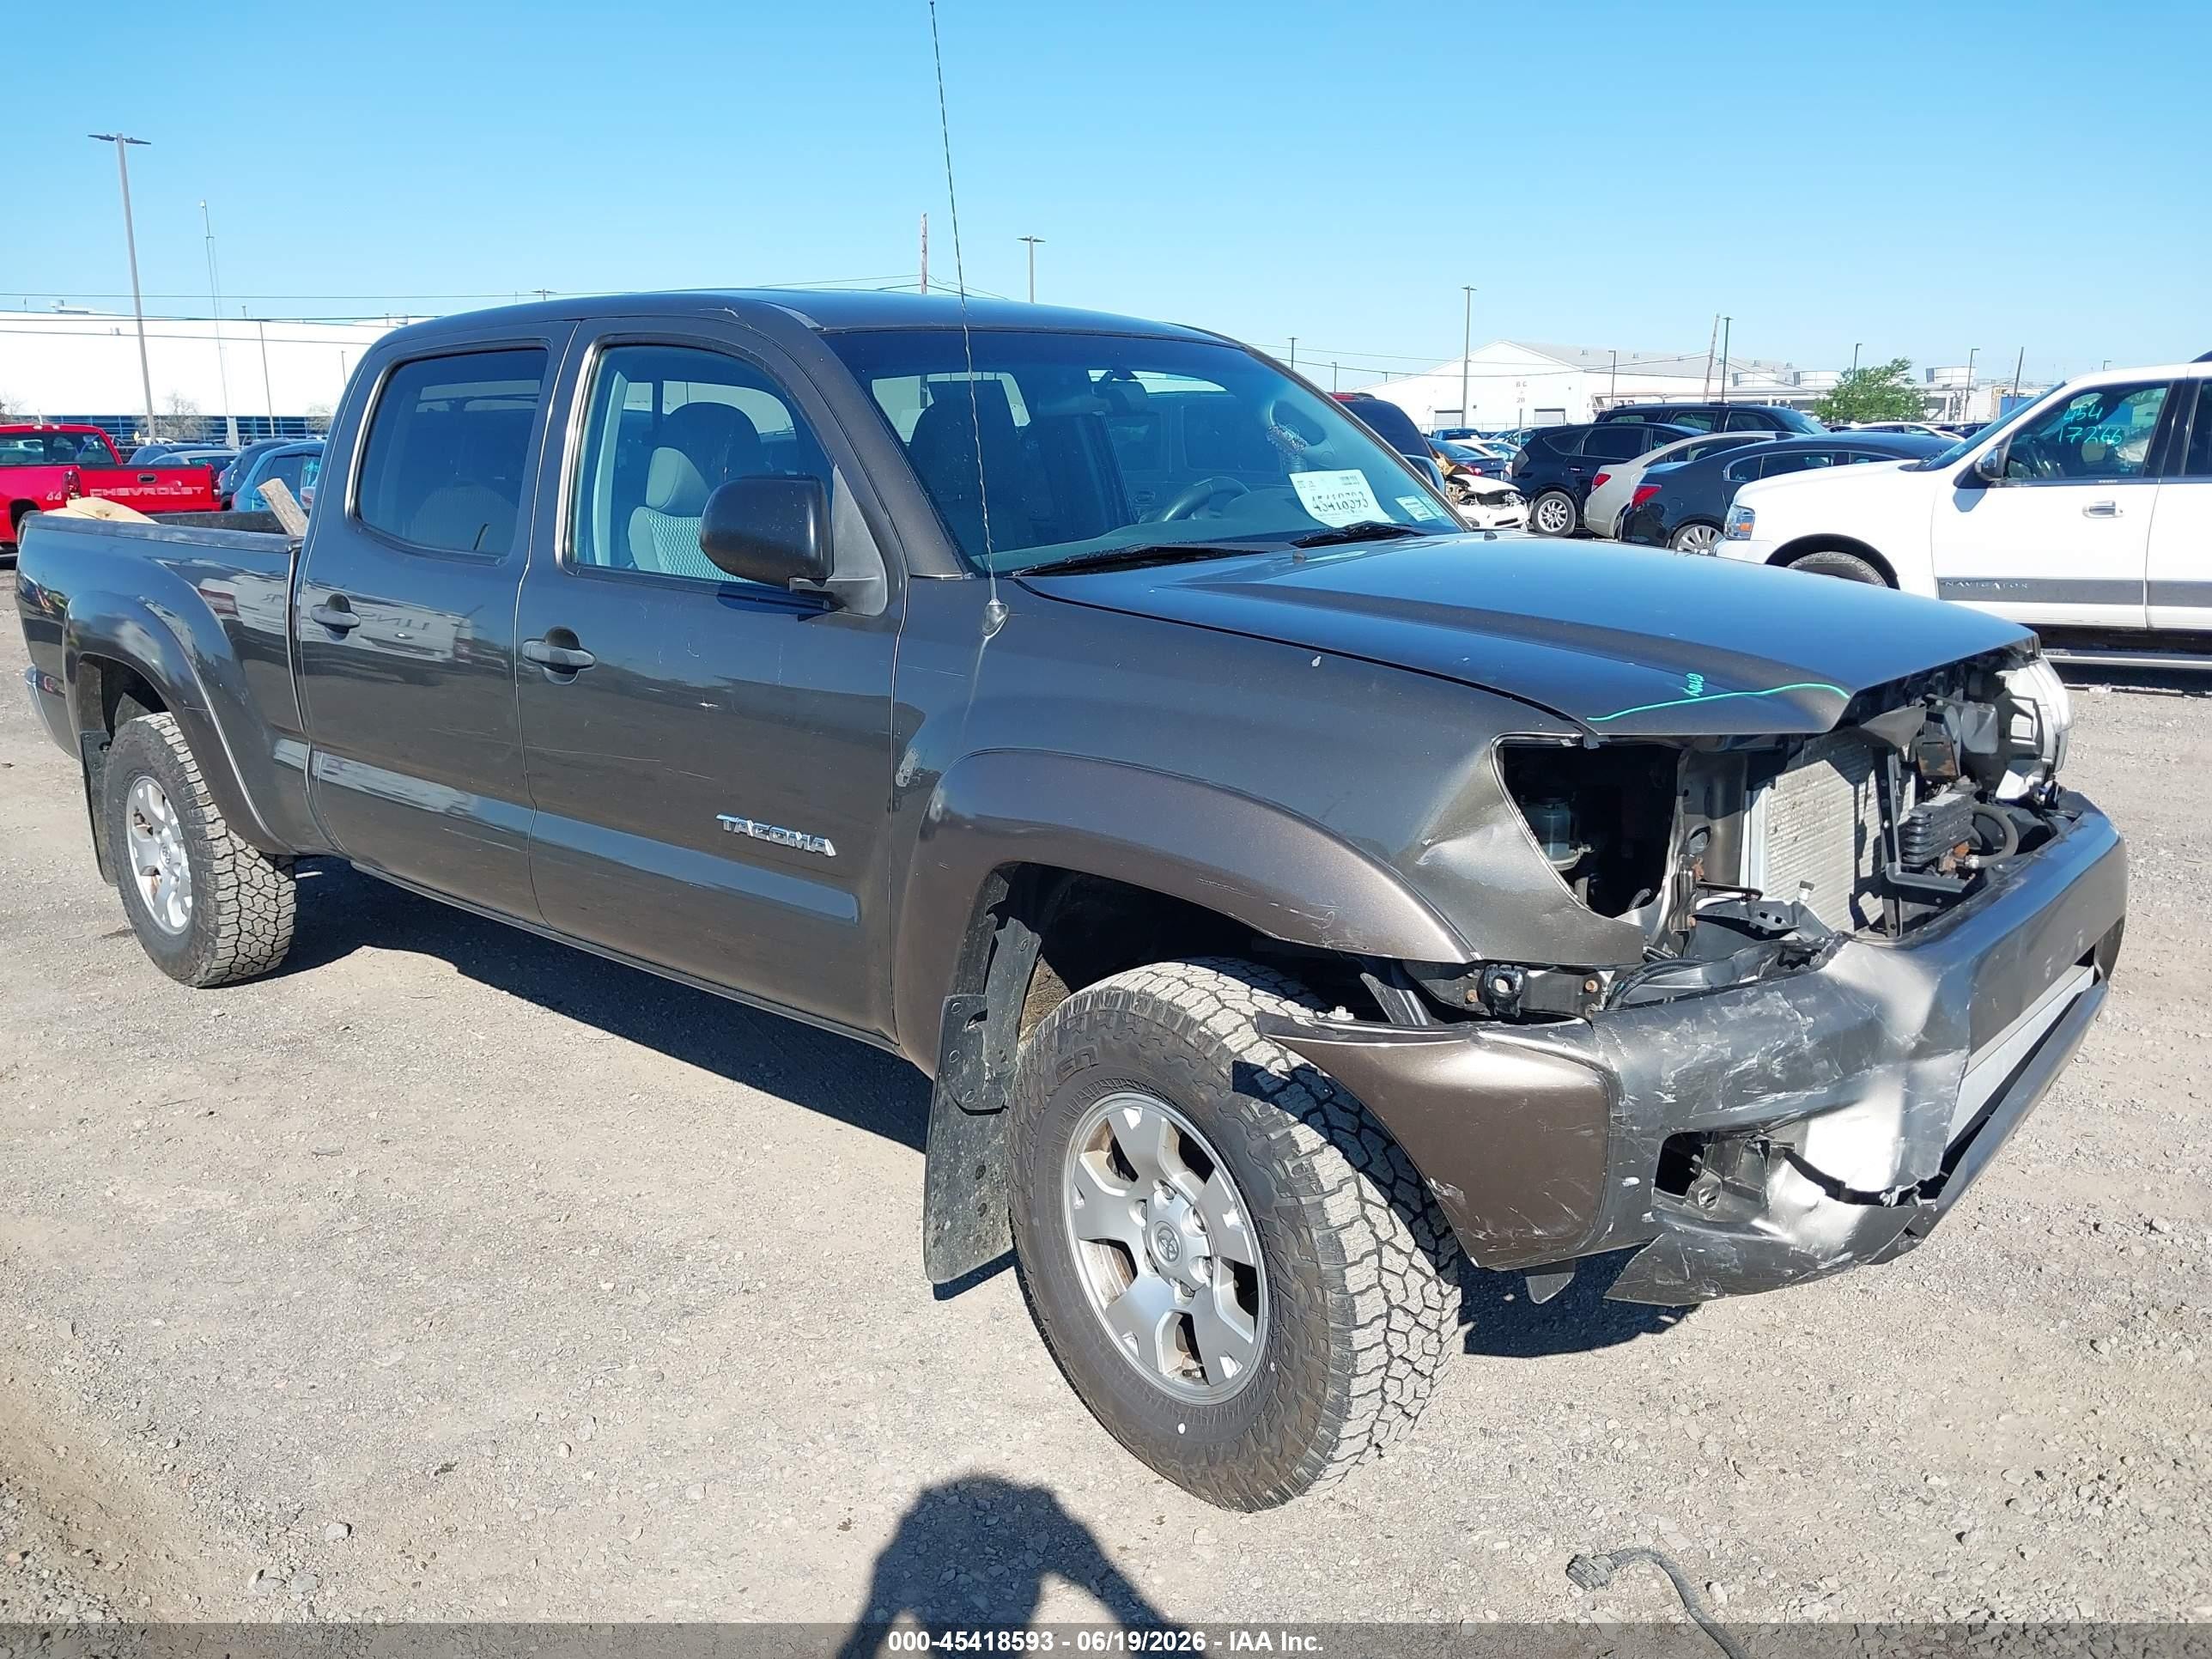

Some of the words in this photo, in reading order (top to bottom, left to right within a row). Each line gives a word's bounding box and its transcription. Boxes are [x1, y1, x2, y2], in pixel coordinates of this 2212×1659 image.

[2058, 425, 2124, 446] 17266
[89, 486, 204, 497] CHEVROLET
[715, 813, 837, 857] TACOMA
